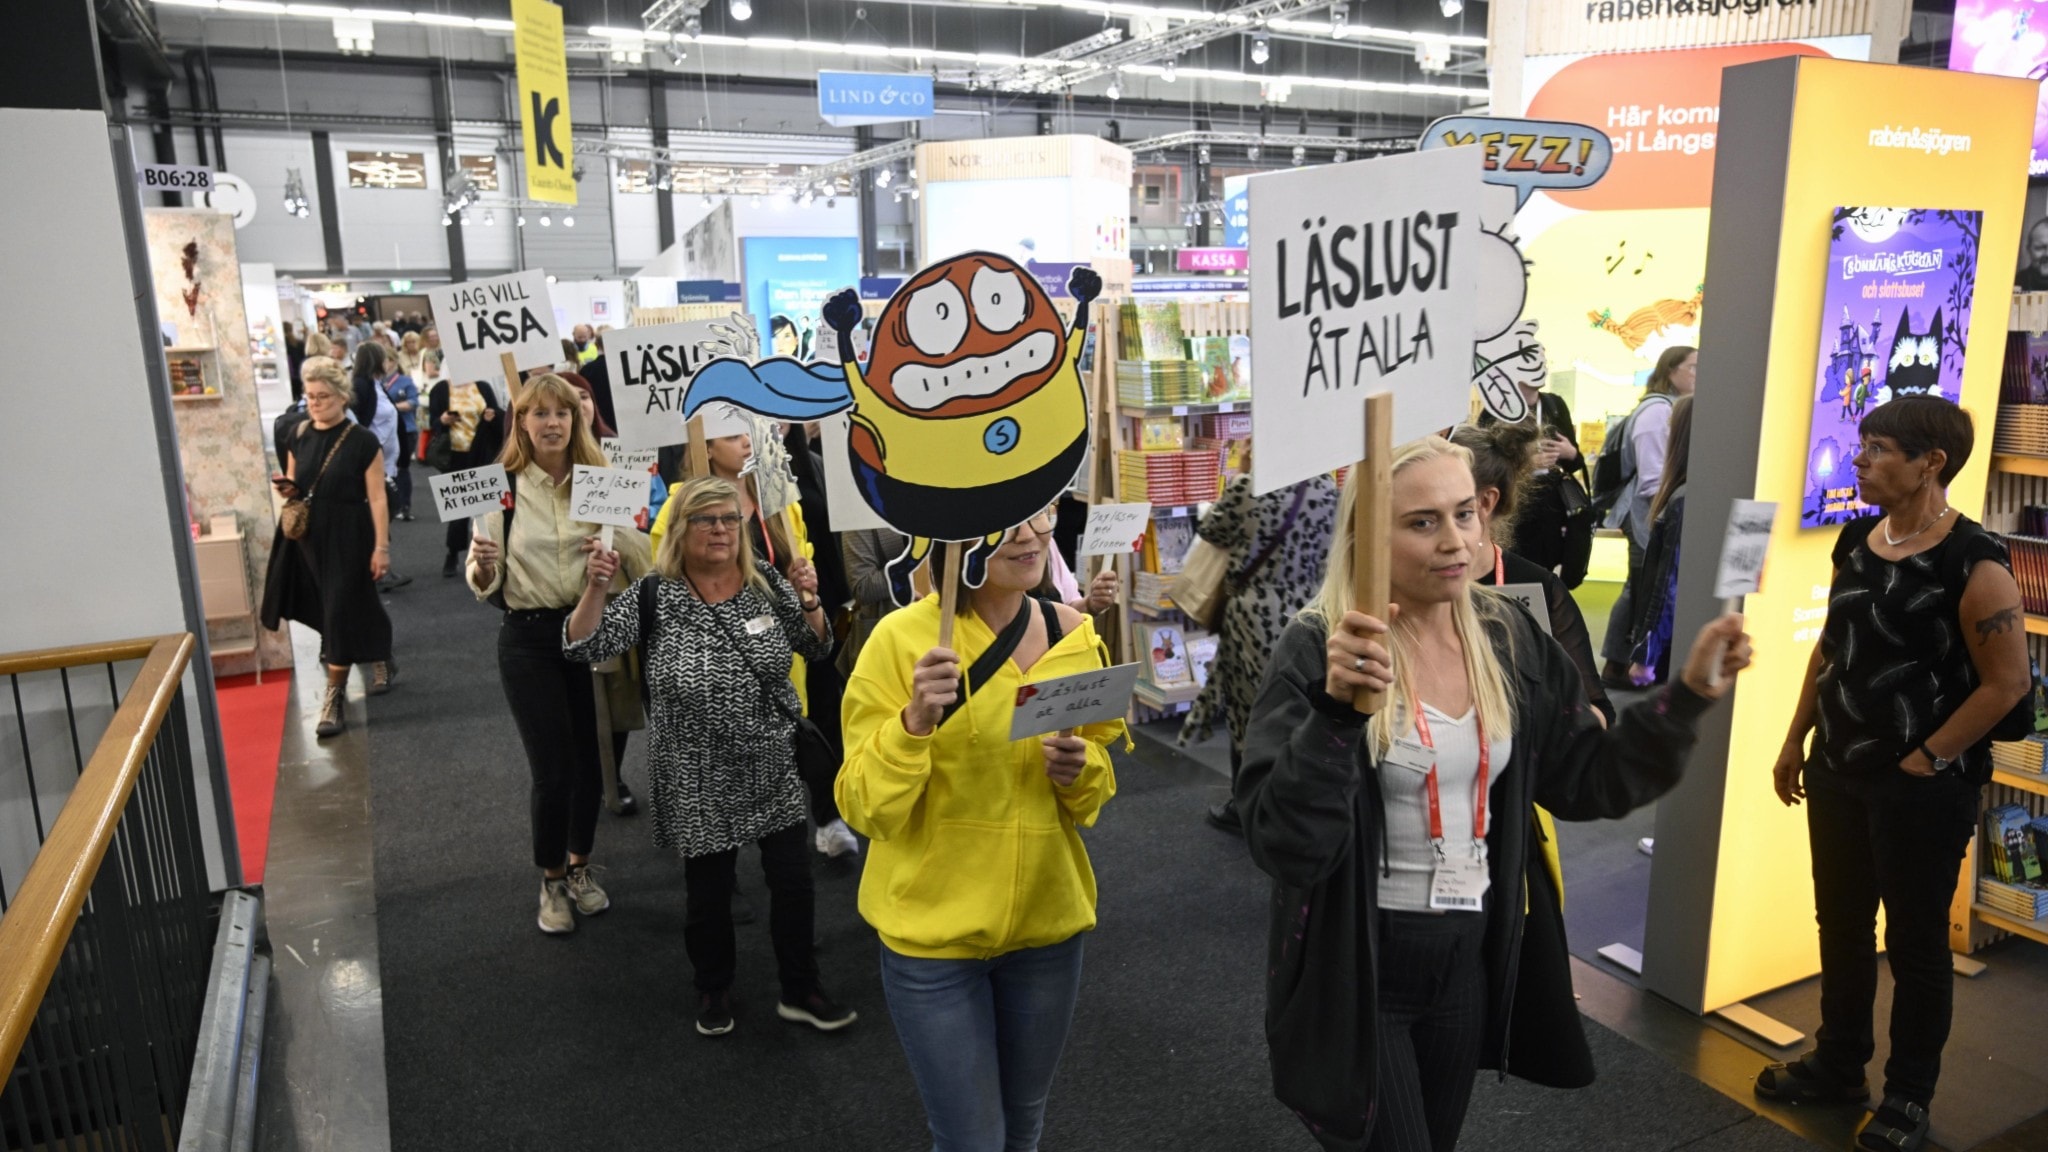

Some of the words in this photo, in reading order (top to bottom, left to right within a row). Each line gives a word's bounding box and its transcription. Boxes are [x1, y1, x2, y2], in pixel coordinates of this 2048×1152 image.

[829, 89, 875, 104] LIND
[879, 84, 899, 105] &
[900, 91, 925, 106] CO
[1607, 105, 1652, 128] Här
[531, 91, 564, 169] K
[1868, 124, 1971, 155] rabén&sjögren
[145, 168, 209, 187] B06:28
[1191, 254, 1236, 267] KASSA
[1277, 210, 1460, 320] LÄSLUST
[449, 287, 487, 312] JAG
[488, 281, 530, 303] VILL
[1862, 279, 1877, 298] och
[456, 306, 549, 351] LÄSA
[1302, 316, 1350, 398] ÅT
[1353, 307, 1434, 386] ALLA
[645, 384, 675, 414] ÅT
[452, 470, 477, 483] MER
[574, 471, 604, 488] Jag
[609, 474, 645, 489] läser
[444, 497, 457, 511] ÅT
[461, 489, 503, 507] FOLKET
[587, 489, 610, 499] med
[1036, 676, 1110, 701] Läslust
[1065, 699, 1102, 712] alla
